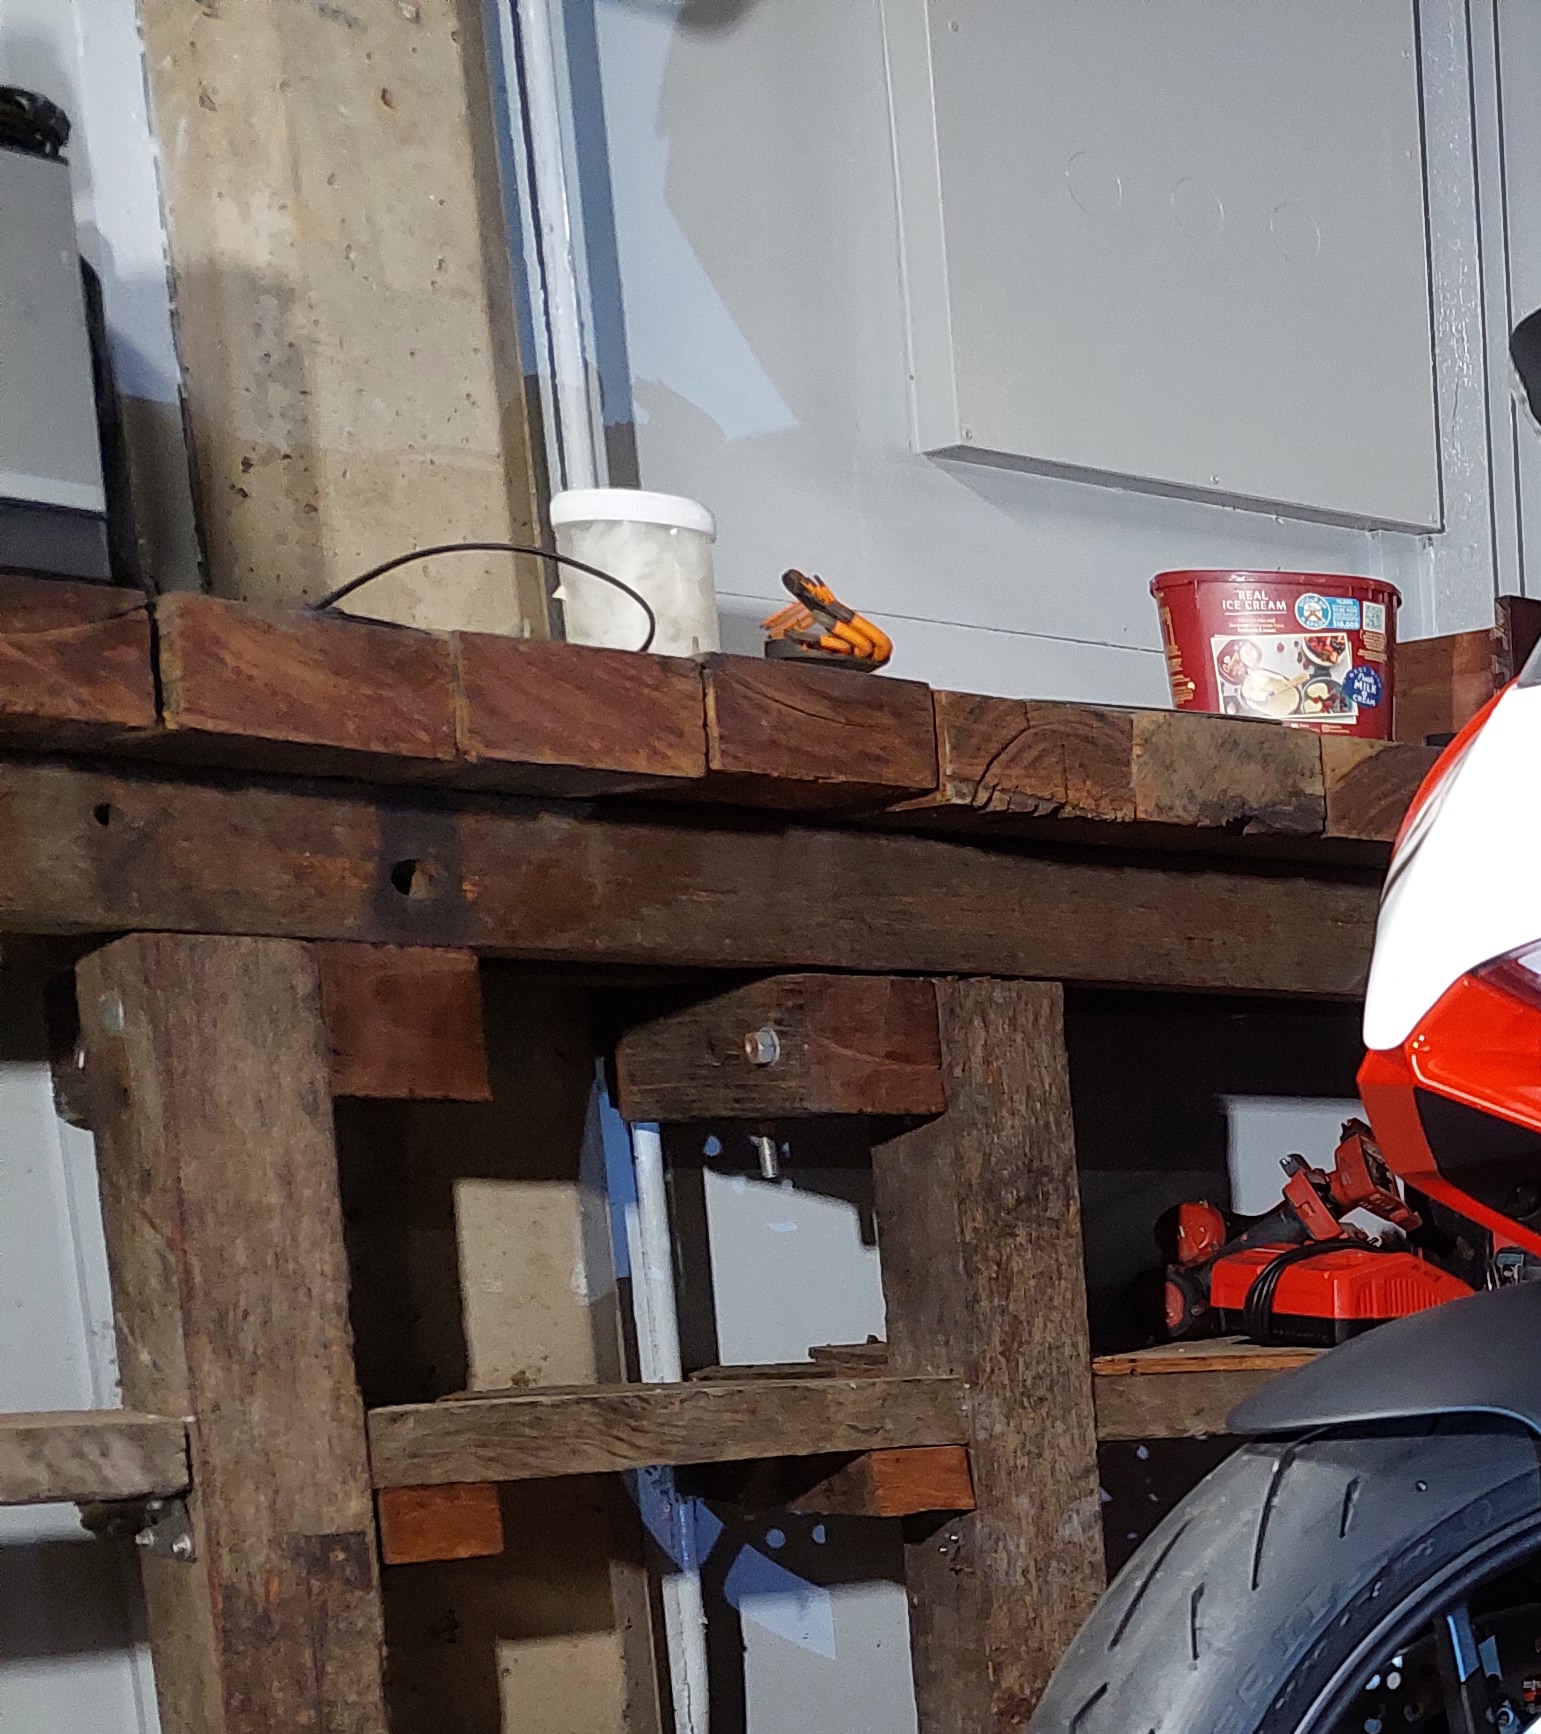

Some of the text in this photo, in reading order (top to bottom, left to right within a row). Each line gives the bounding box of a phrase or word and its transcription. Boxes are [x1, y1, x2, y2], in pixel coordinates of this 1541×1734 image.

[1238, 589, 1269, 601] REAL
[1222, 599, 1287, 611] ICE CREAM
[1353, 679, 1377, 695] MILK
